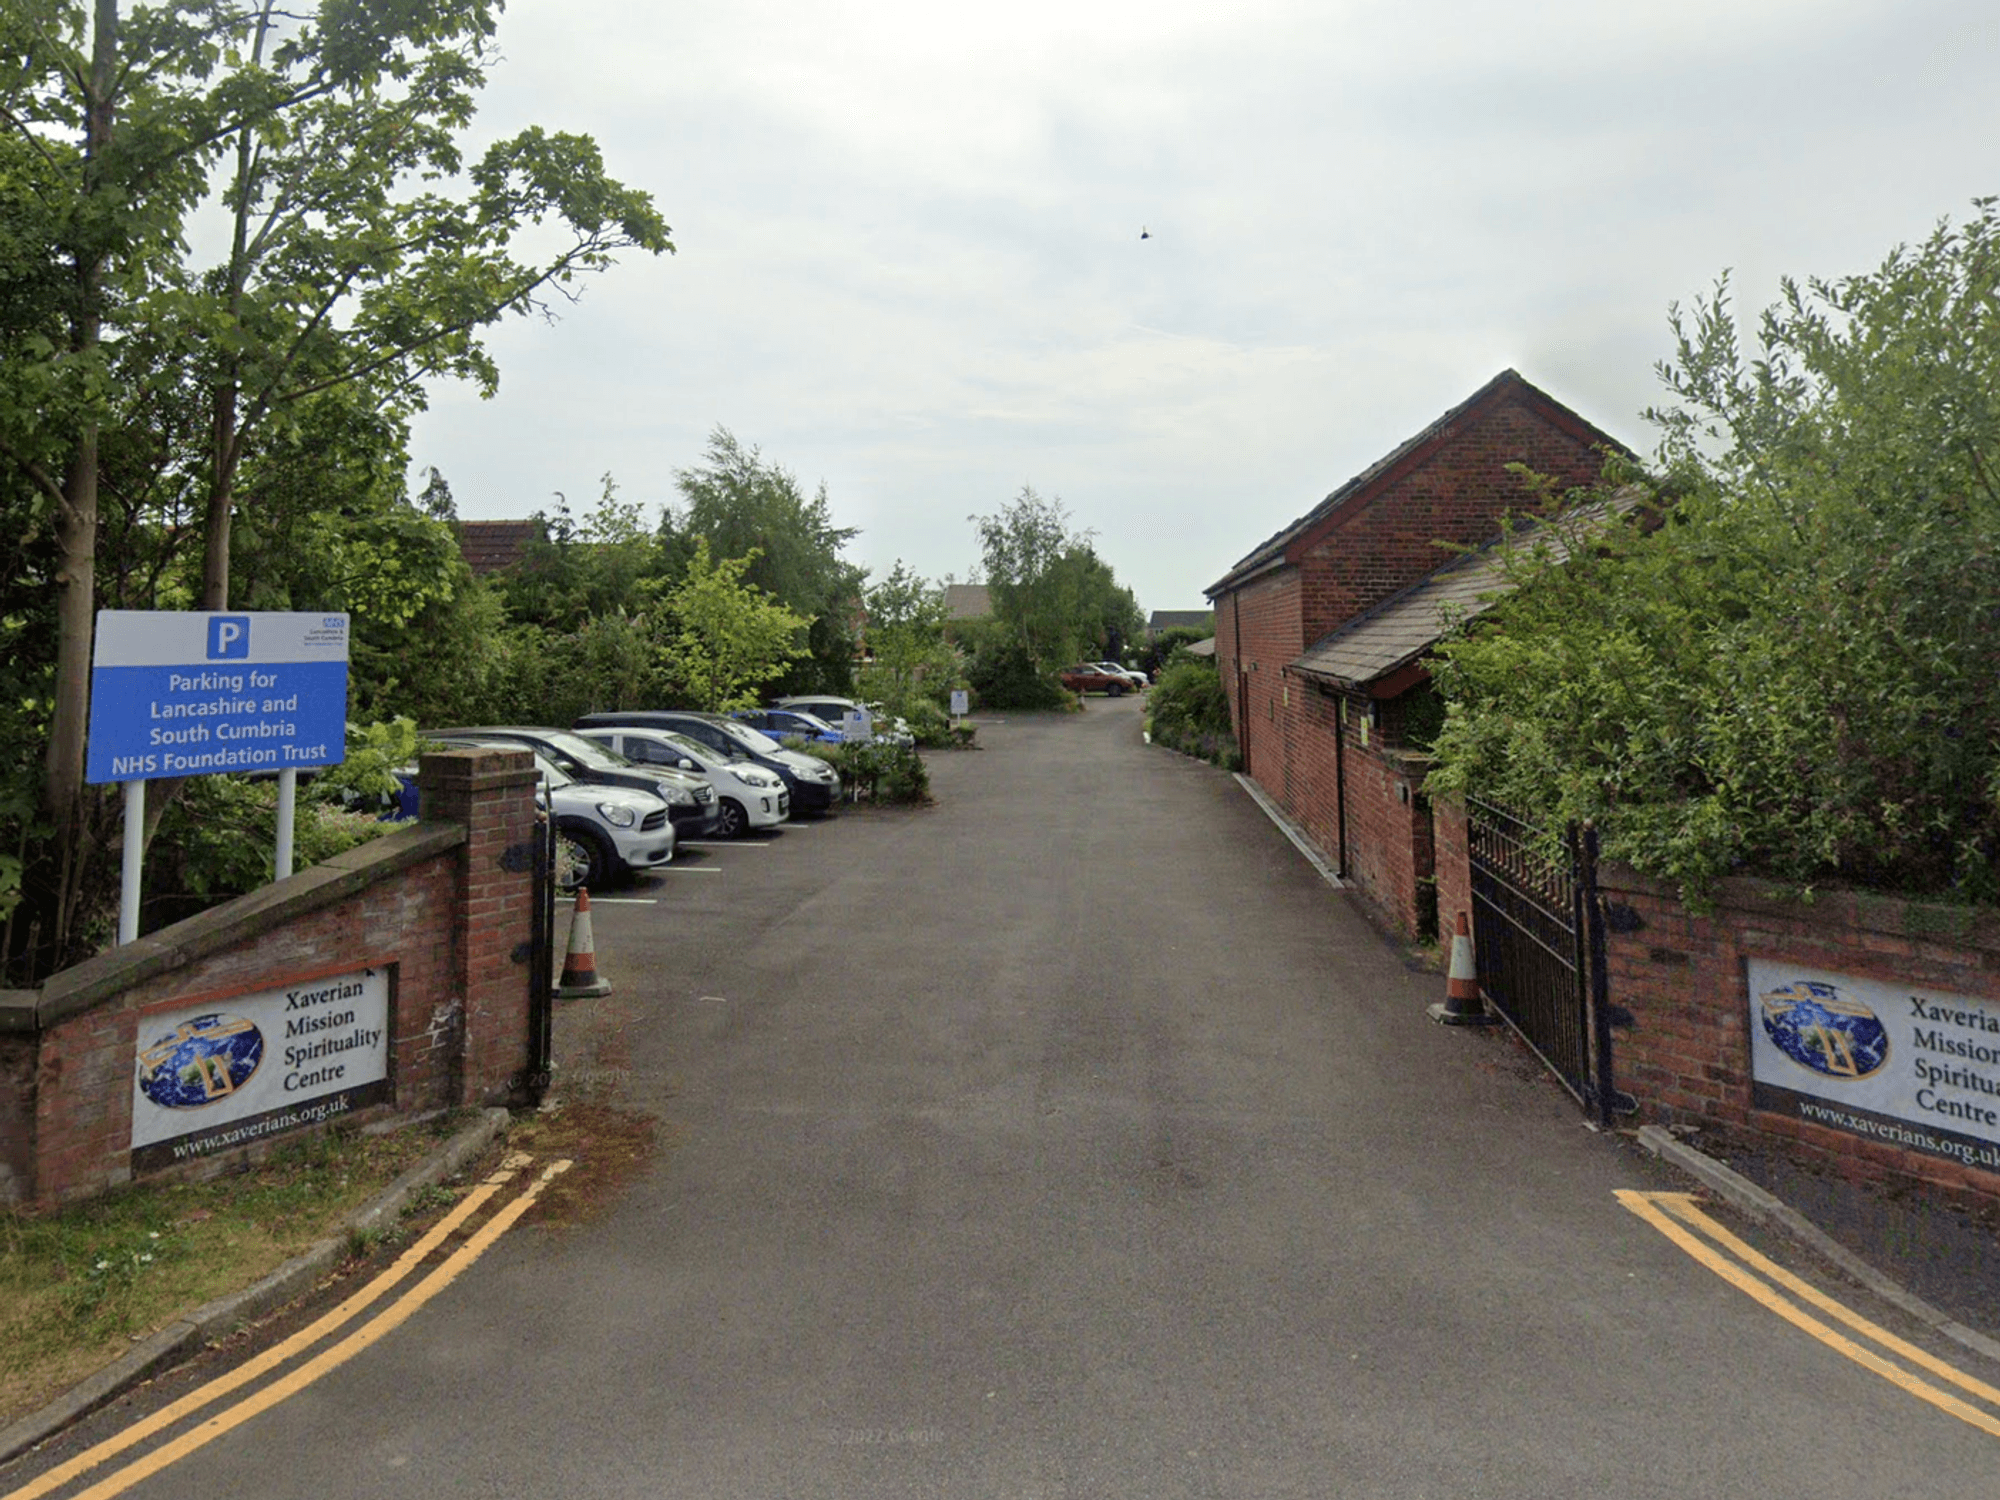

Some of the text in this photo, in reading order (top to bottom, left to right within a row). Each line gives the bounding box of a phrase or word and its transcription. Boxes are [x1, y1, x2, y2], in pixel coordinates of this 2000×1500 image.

[218, 622, 239, 653] P
[169, 670, 278, 692] Parking for
[151, 693, 297, 719] Lancashire and
[150, 720, 296, 746] South Cumbria
[112, 743, 327, 775] NHS Foundation Trust
[285, 981, 364, 1012] Xaverian
[285, 1010, 355, 1039] Mission
[284, 1027, 382, 1067] Spirituality
[283, 1062, 346, 1093] Centre
[1915, 1088, 1998, 1126] Centre
[172, 1095, 349, 1158] www.xaverians.org.uk
